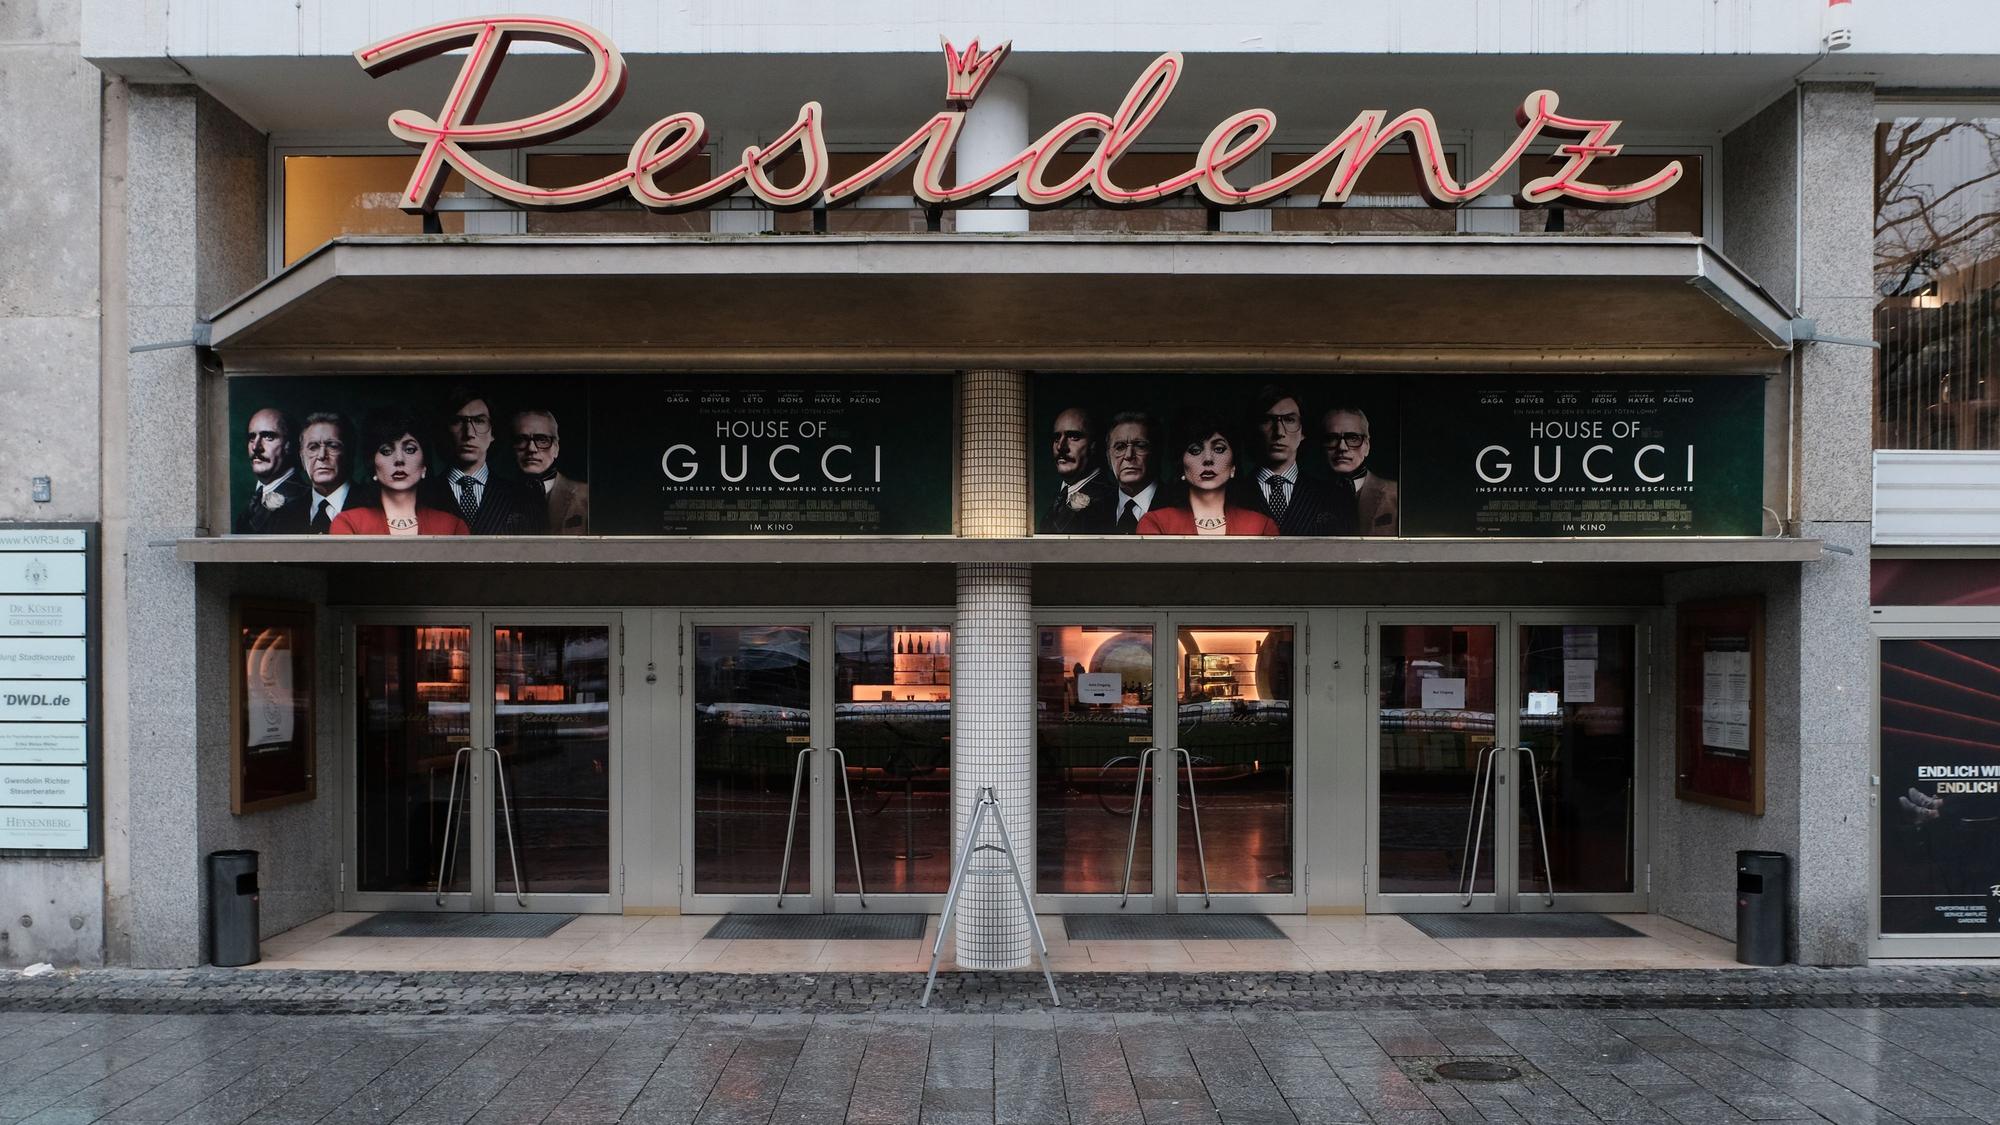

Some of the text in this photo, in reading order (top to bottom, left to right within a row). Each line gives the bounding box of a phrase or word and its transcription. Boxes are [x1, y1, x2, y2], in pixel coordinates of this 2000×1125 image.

[354, 14, 1684, 212] Residenz
[716, 420, 827, 438] HOUSE OF
[1530, 421, 1602, 439] HOUSE
[1612, 421, 1640, 439] OF
[661, 443, 881, 483] GUCCI
[1475, 444, 1694, 483] GUCCI
[750, 523, 794, 531] IM KINO
[1562, 523, 1606, 531] IM KINO
[6, 694, 70, 706] DWDL.de
[1918, 766, 1979, 777] ENDLICH
[1937, 782, 1998, 793] ENDLICH
